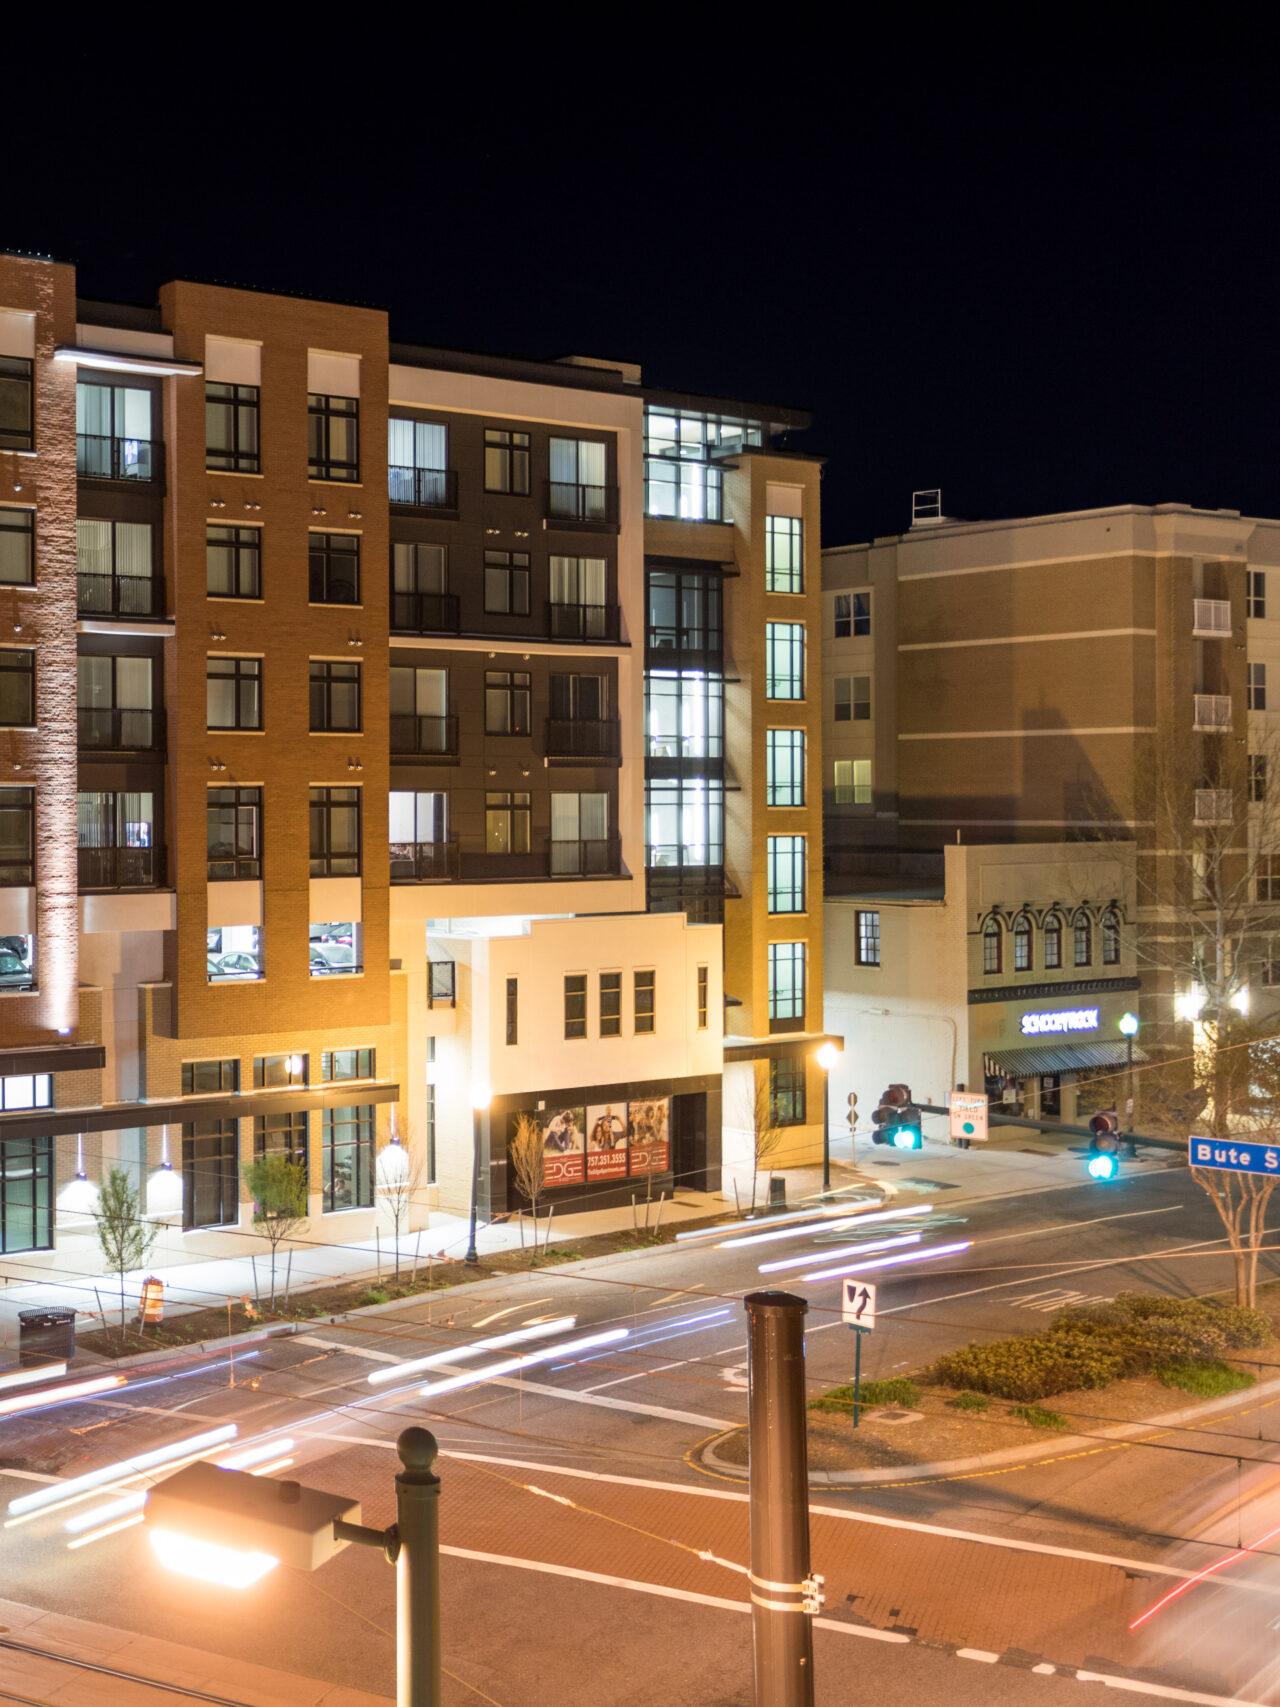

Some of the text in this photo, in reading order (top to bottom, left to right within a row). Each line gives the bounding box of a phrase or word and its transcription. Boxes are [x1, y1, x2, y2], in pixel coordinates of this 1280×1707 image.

[587, 1153, 626, 1167] 757.351.3555
[1197, 1144, 1280, 1169] Bute S
